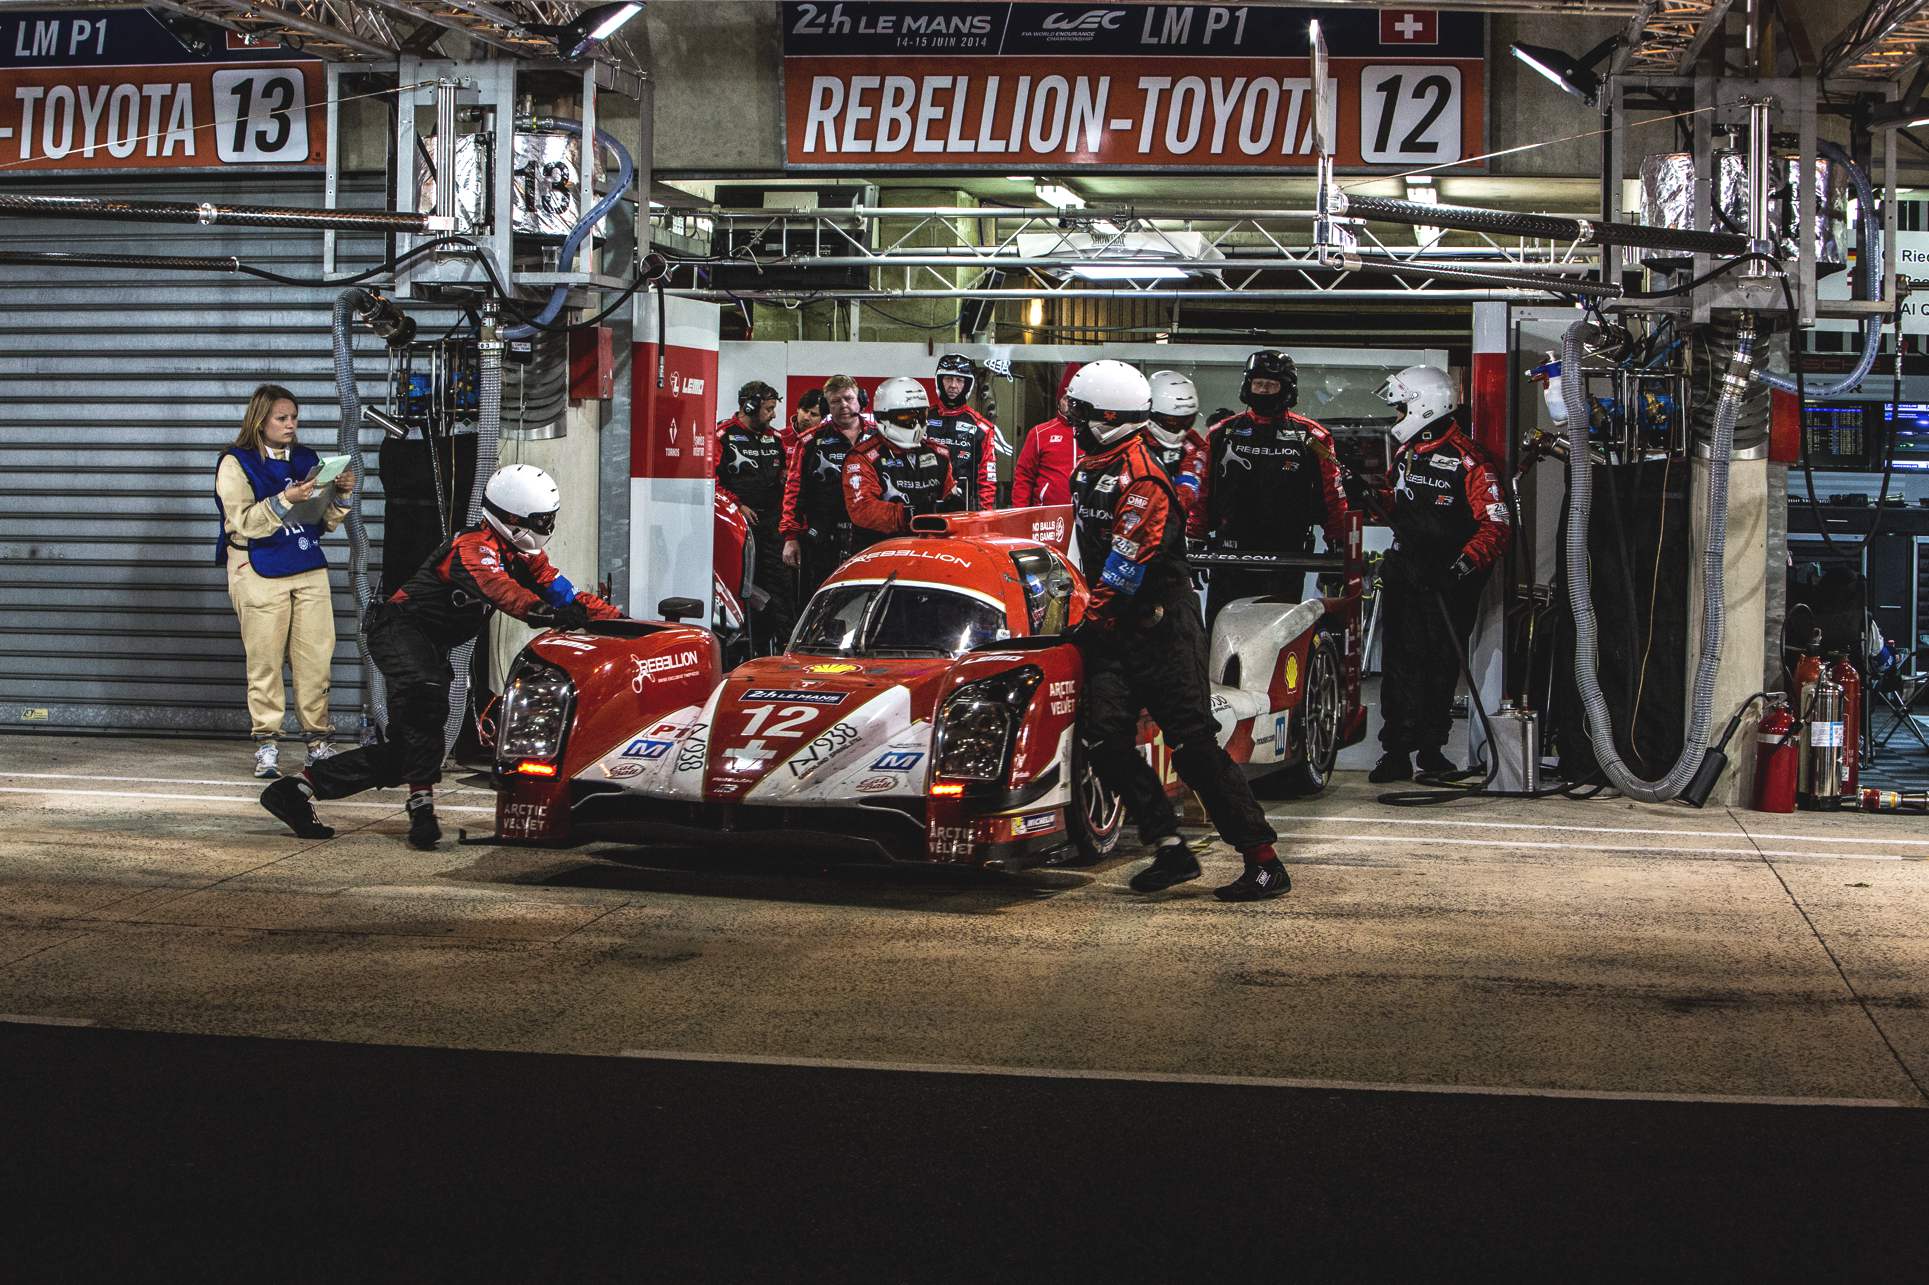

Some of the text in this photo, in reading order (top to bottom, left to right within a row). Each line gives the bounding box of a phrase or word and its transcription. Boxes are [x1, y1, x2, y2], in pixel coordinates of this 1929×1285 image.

[858, 16, 897, 34] LE
[901, 16, 992, 34] MANS
[1140, 6, 1249, 45] LM P1
[15, 18, 108, 57] LM P1
[896, 36, 988, 48] 14-15 JUIN 2014
[230, 76, 297, 154] 13
[1373, 74, 1452, 154] 12
[1235, 445, 1301, 457] REBELLION
[853, 549, 973, 568] REBELLION
[640, 651, 699, 674] REBELLION
[1049, 680, 1076, 697] ARCTIC
[798, 694, 840, 702] MANS
[1050, 699, 1075, 716] VELVET
[740, 704, 820, 738] 12
[650, 724, 691, 739] P1
[504, 803, 548, 817] ARCTIC
[503, 817, 545, 831] VELVET
[1026, 814, 1056, 829] MICHELIN
[929, 826, 975, 841] ARCTIC
